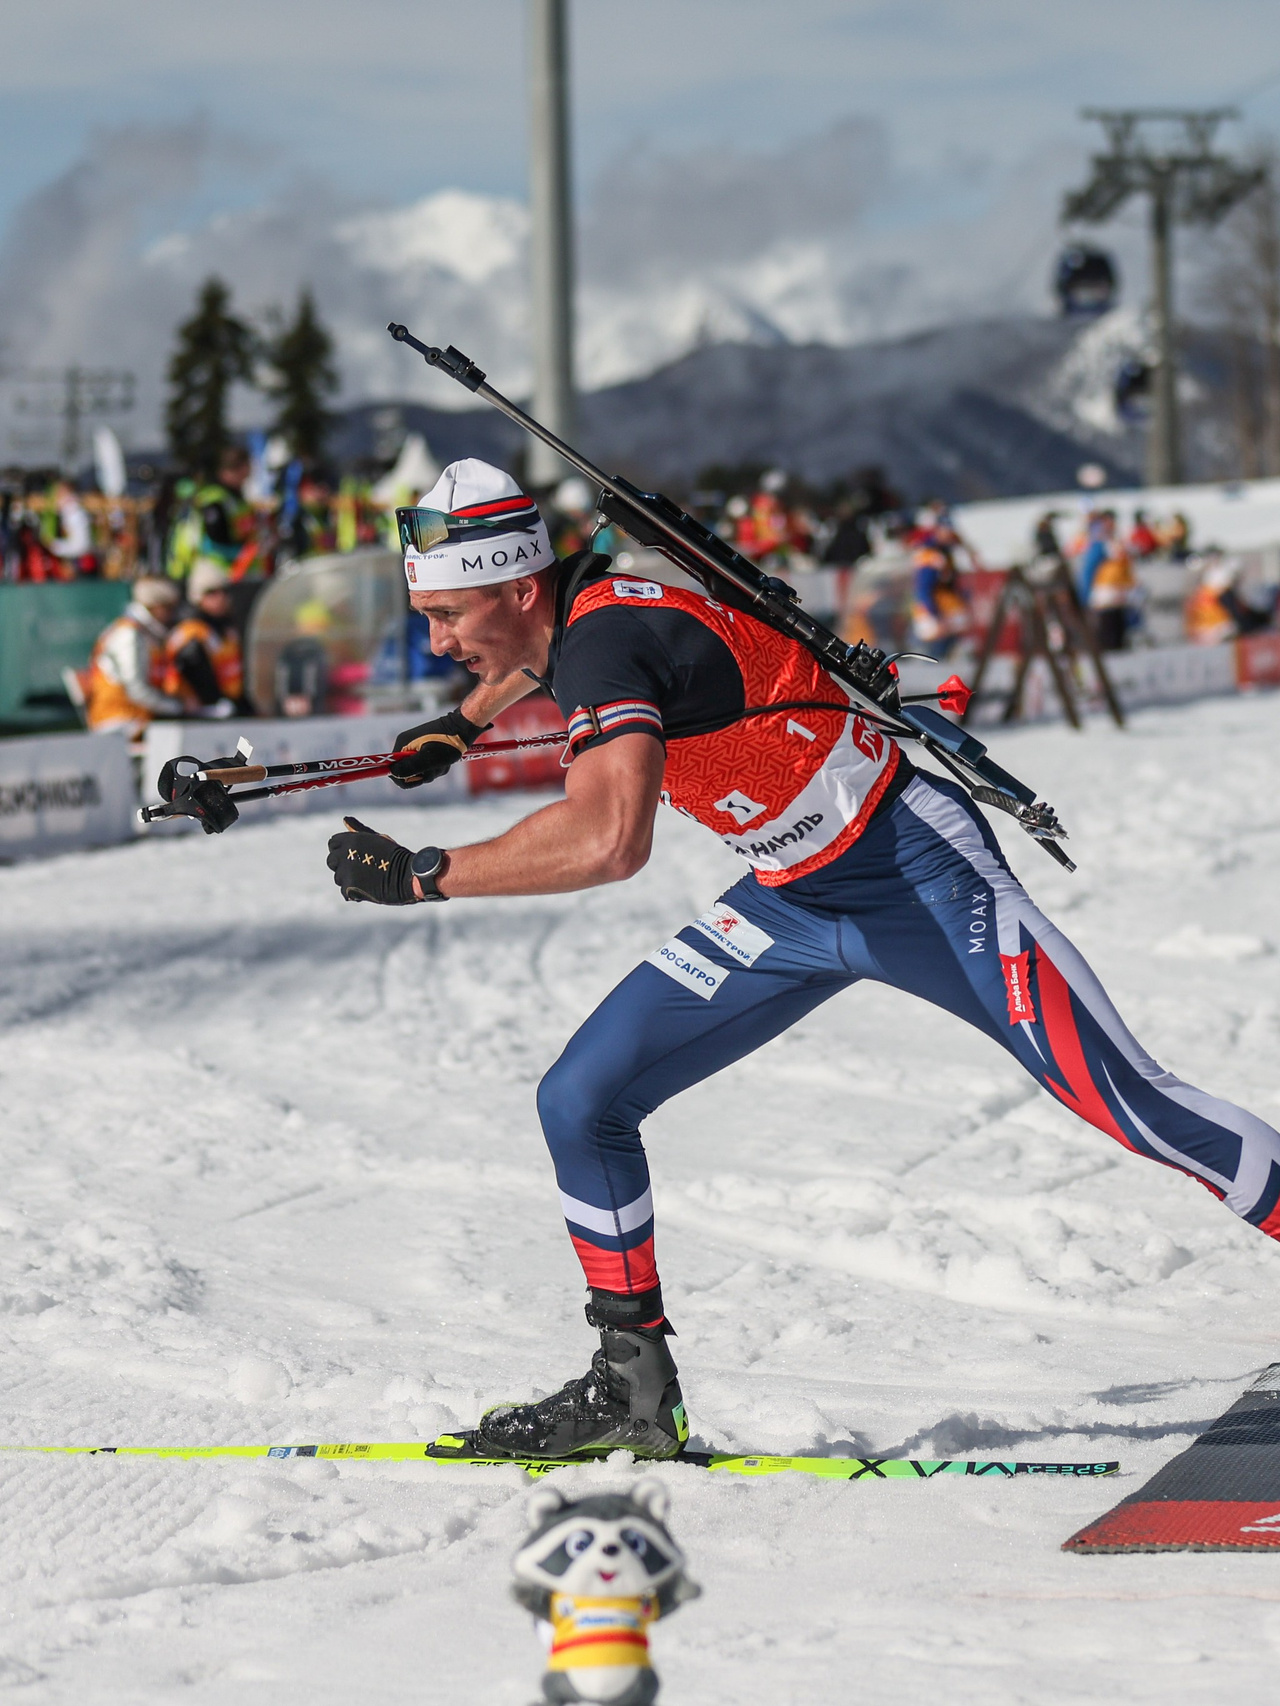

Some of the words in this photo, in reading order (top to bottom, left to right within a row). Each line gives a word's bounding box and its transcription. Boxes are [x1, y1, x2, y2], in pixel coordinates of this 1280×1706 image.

[461, 540, 542, 572] MOAX
[786, 718, 817, 743] 1
[318, 754, 397, 771] MOAX
[267, 780, 342, 799] MOAX
[968, 892, 987, 954] MOAX
[660, 947, 716, 987] ФОСАГРО
[1011, 963, 1019, 985] Банк
[1013, 985, 1026, 1012] Альфа
